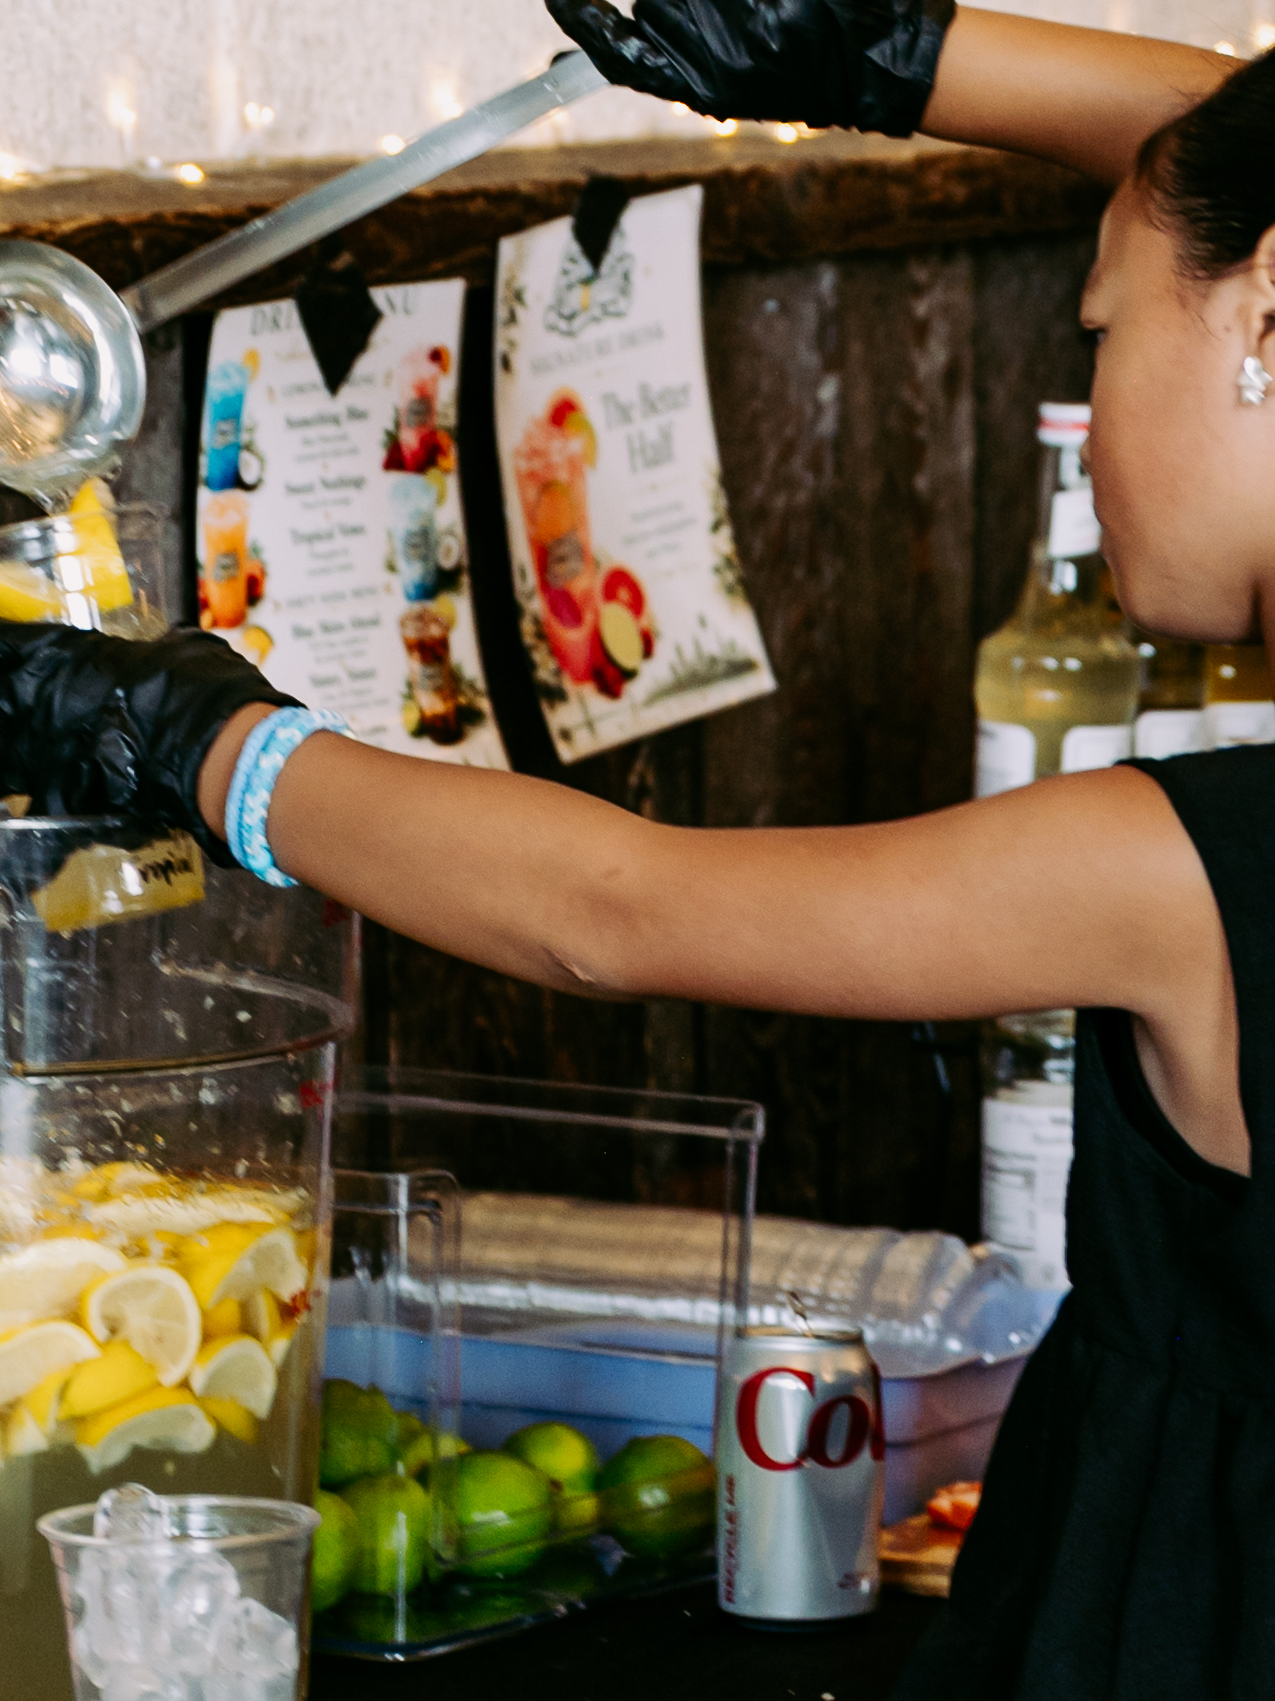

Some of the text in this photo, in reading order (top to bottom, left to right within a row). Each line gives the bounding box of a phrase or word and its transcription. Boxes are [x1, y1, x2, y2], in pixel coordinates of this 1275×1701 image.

[601, 380, 691, 430] The Better
[627, 420, 676, 475] Half
